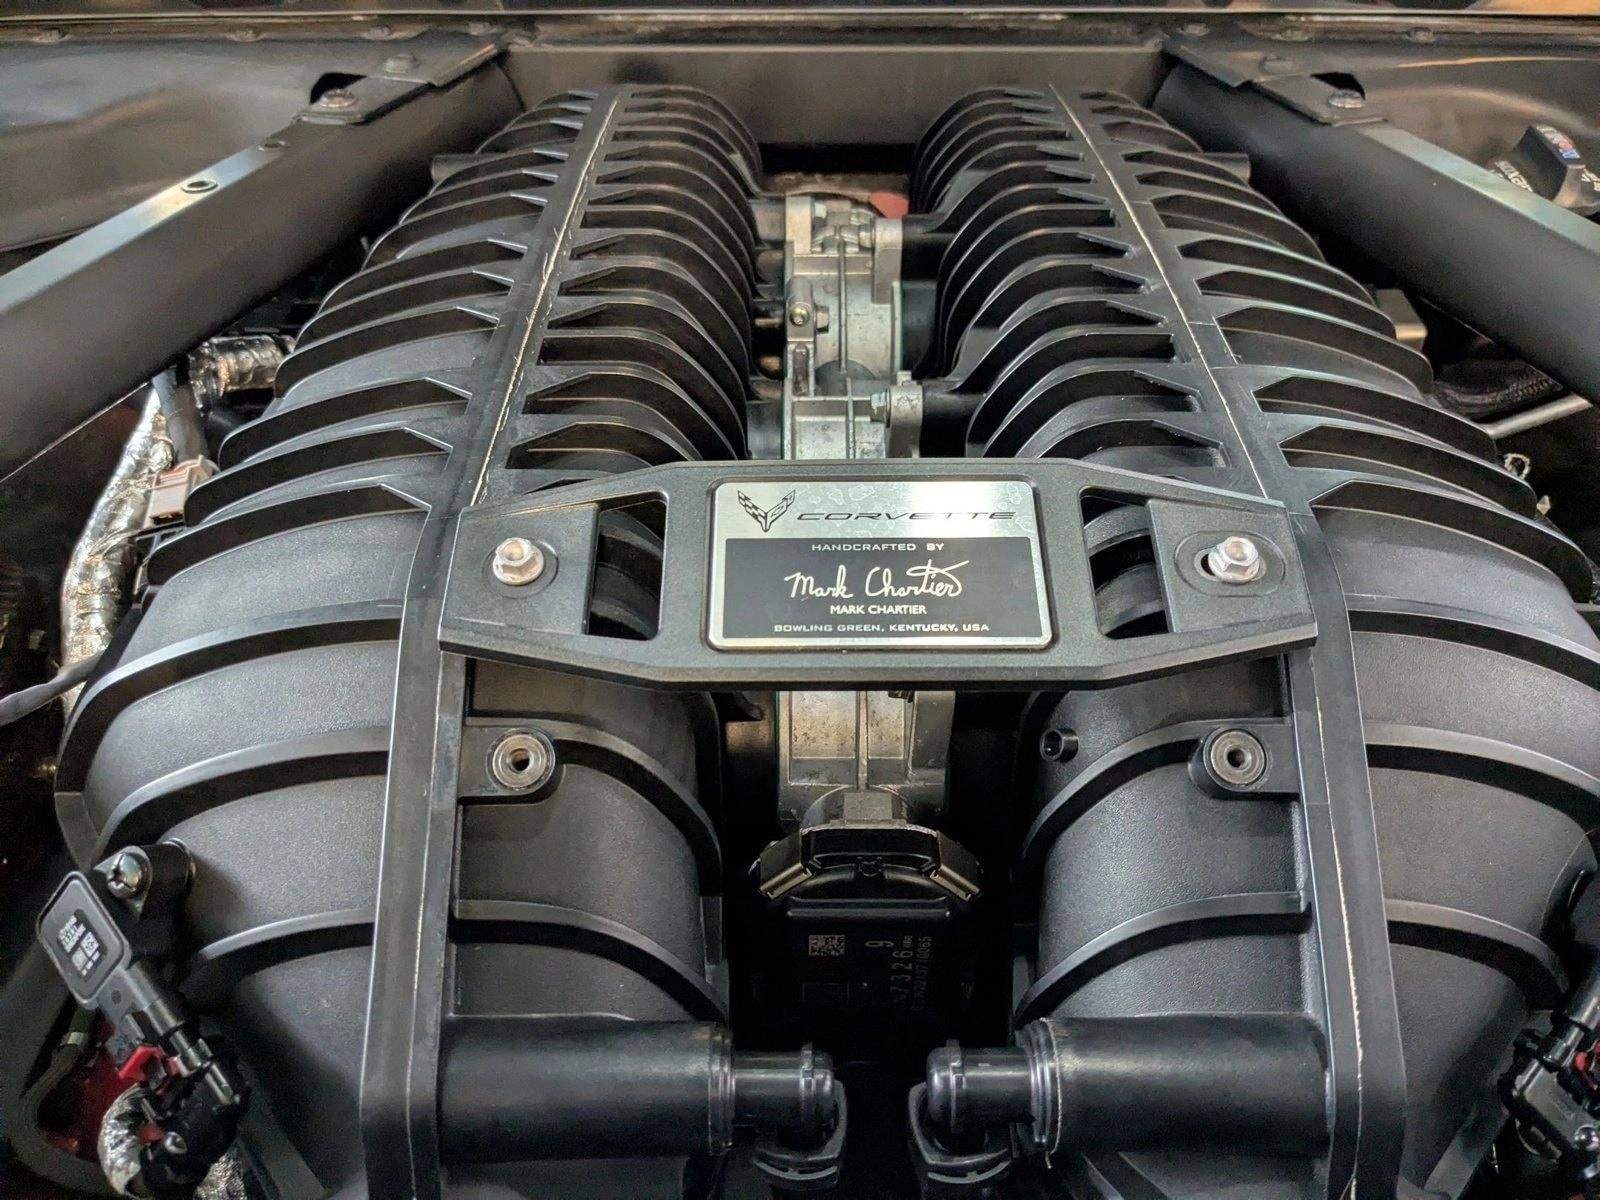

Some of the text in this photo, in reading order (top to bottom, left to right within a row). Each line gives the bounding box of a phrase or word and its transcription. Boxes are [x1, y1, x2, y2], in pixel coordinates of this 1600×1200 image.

[797, 511, 1017, 521] CORVETTE
[811, 542, 945, 551] HANDCRAFTED BY
[783, 558, 970, 599] Mark Chartier
[830, 604, 928, 615] MARK CHARTIER
[774, 623, 990, 633] BOWLING GREEN, KENTUCKY, USA
